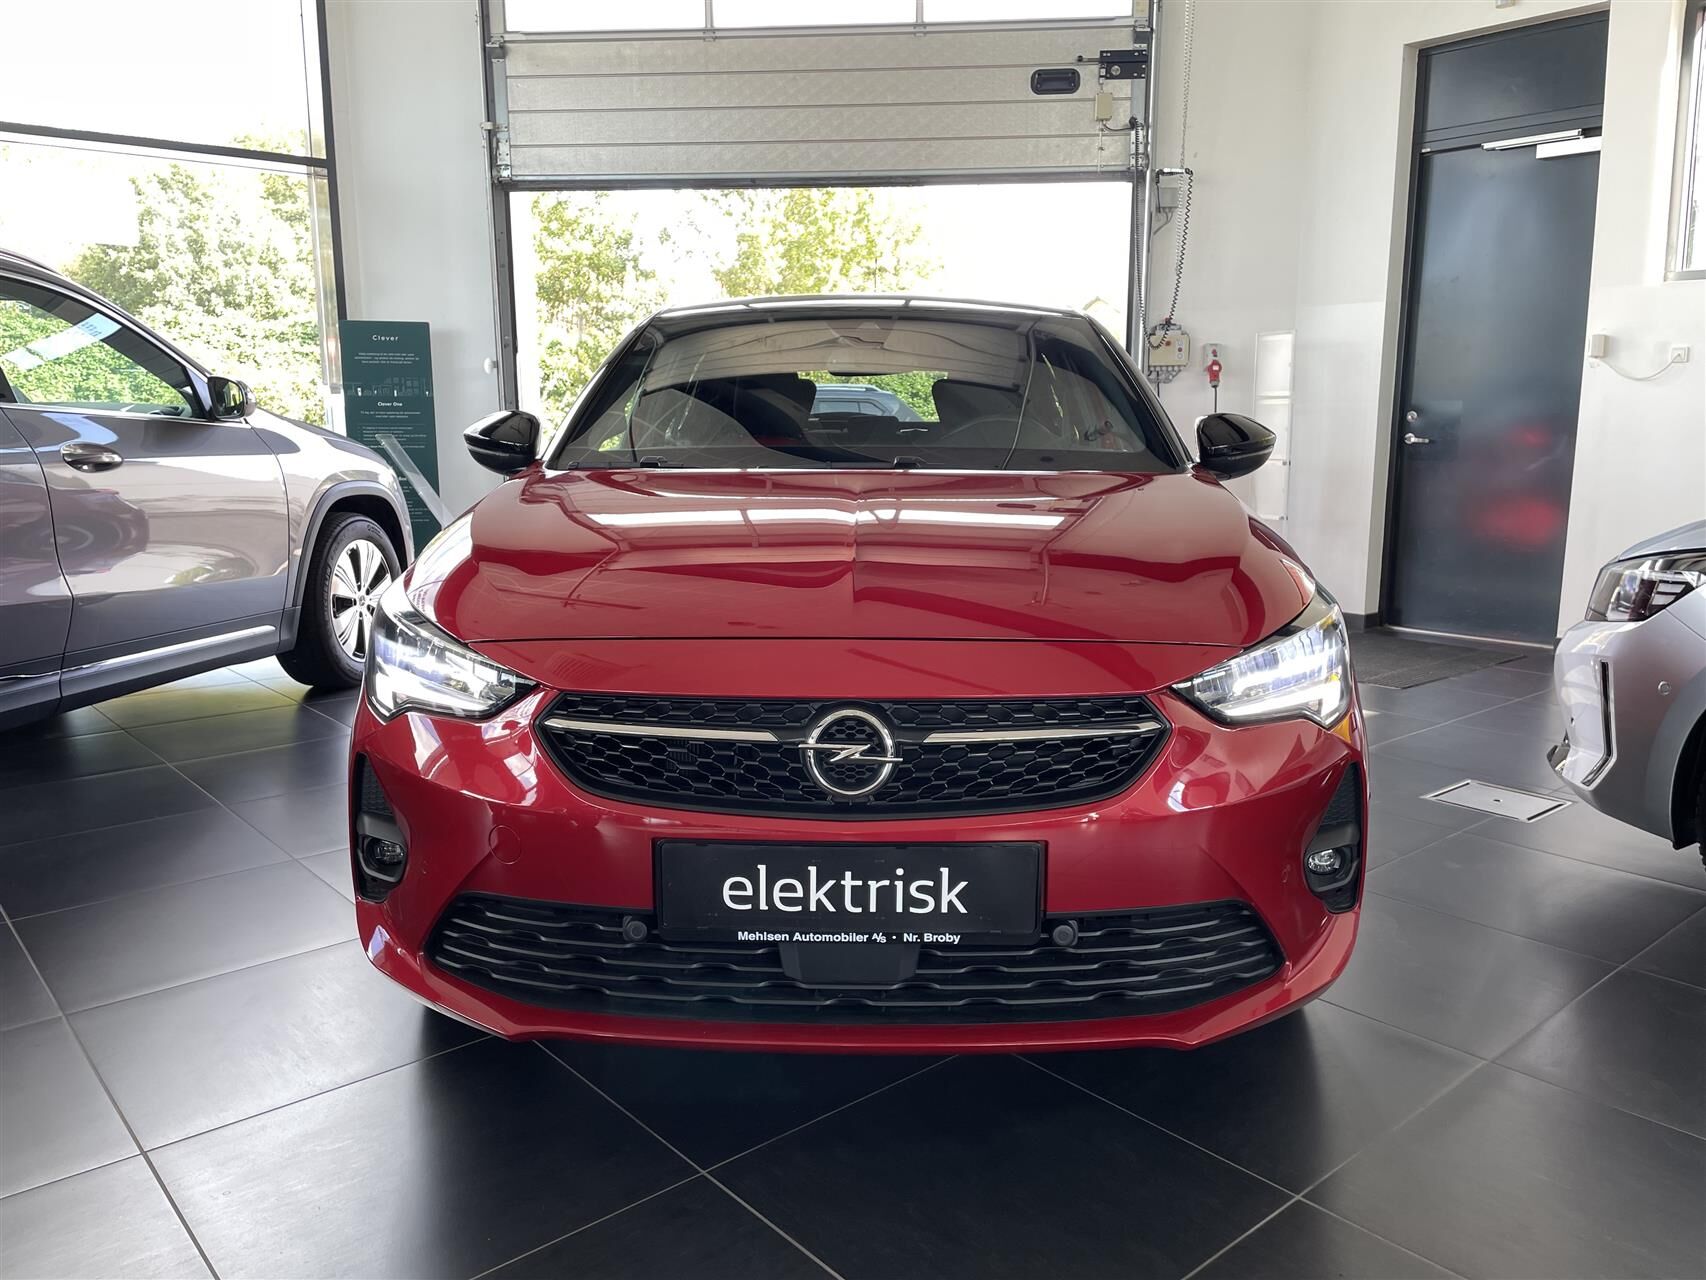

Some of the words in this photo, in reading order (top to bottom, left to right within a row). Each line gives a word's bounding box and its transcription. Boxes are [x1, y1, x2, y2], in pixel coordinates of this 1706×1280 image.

[722, 864, 969, 914] elektrisk
[737, 931, 790, 942] Mehlsen
[792, 932, 869, 943] Automobiler
[903, 932, 921, 943] Nr.
[923, 932, 960, 944] Broby
